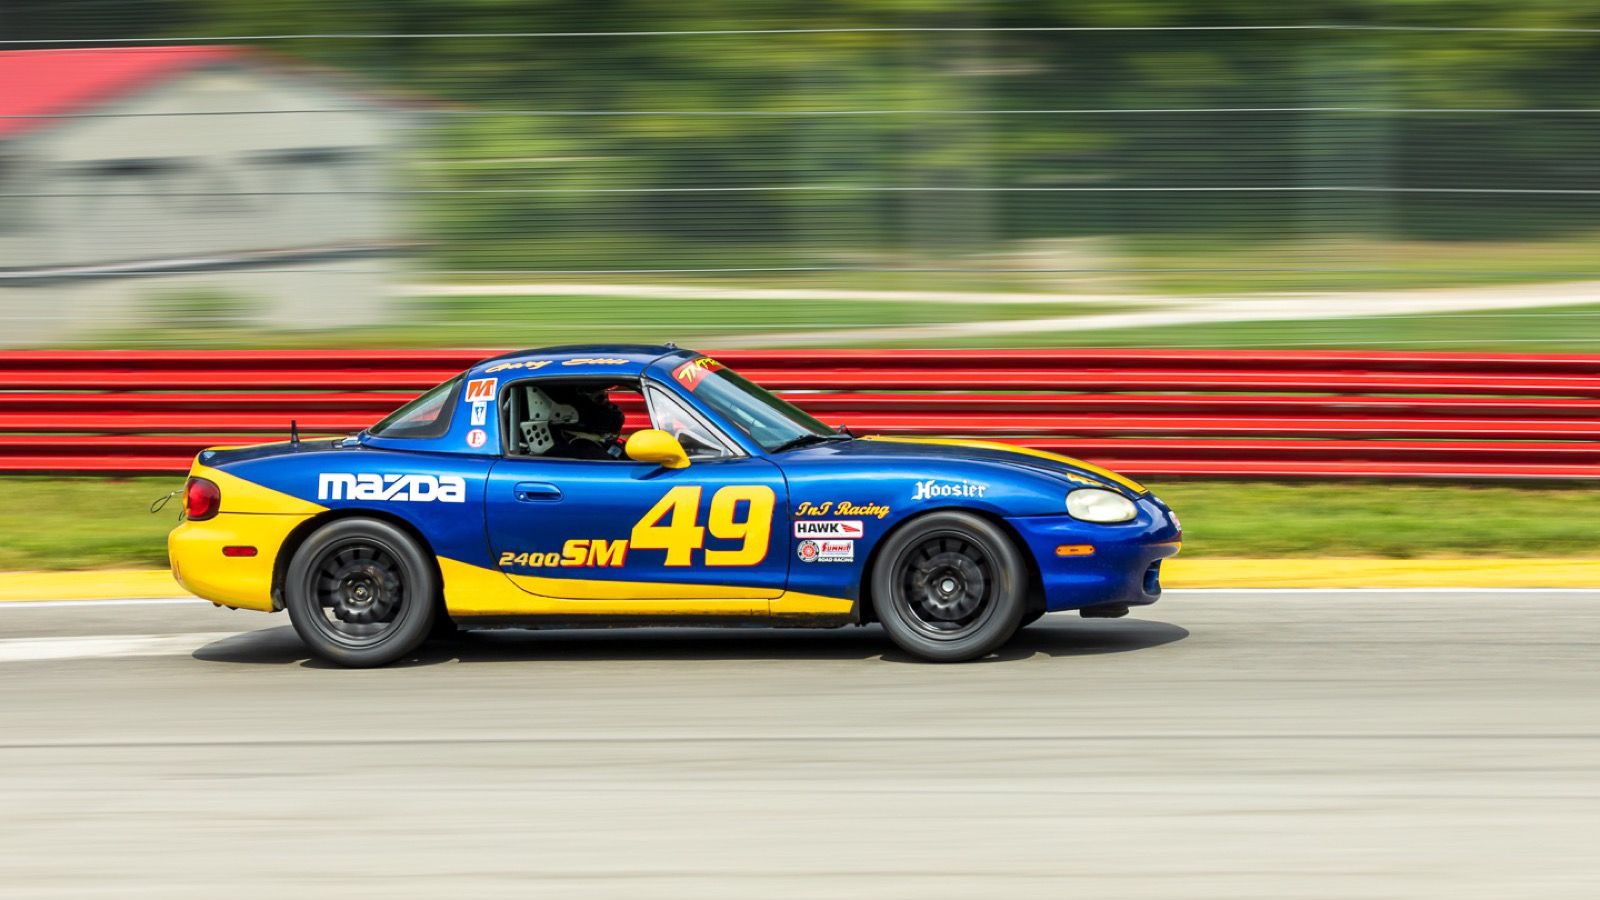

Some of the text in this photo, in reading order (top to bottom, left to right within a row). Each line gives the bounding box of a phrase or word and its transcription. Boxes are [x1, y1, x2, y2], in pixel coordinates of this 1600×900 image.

[912, 480, 987, 500] Hoosier
[834, 501, 890, 520] Racing
[630, 485, 776, 567] 49
[797, 522, 840, 533] HAWK
